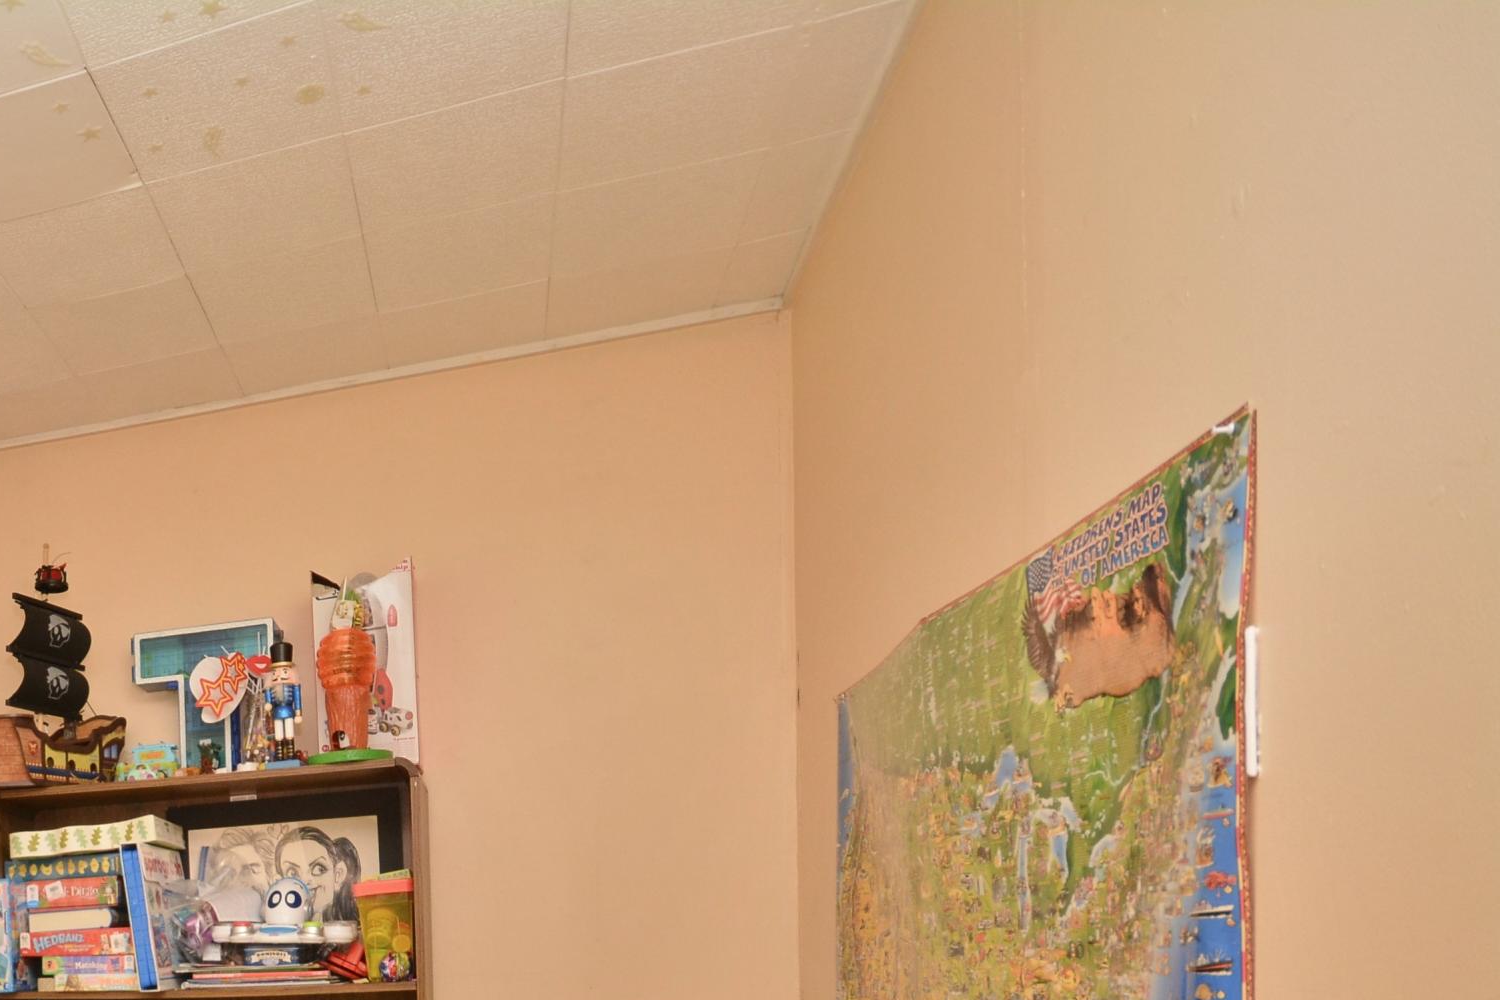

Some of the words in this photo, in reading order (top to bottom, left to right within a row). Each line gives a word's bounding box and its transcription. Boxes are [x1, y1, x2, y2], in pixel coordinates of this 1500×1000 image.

[1128, 483, 1161, 518] MAP
[1063, 537, 1109, 577] UNITED
[1114, 505, 1166, 548] STATES
[1080, 563, 1097, 585] OF
[1100, 526, 1169, 578] AMERICA
